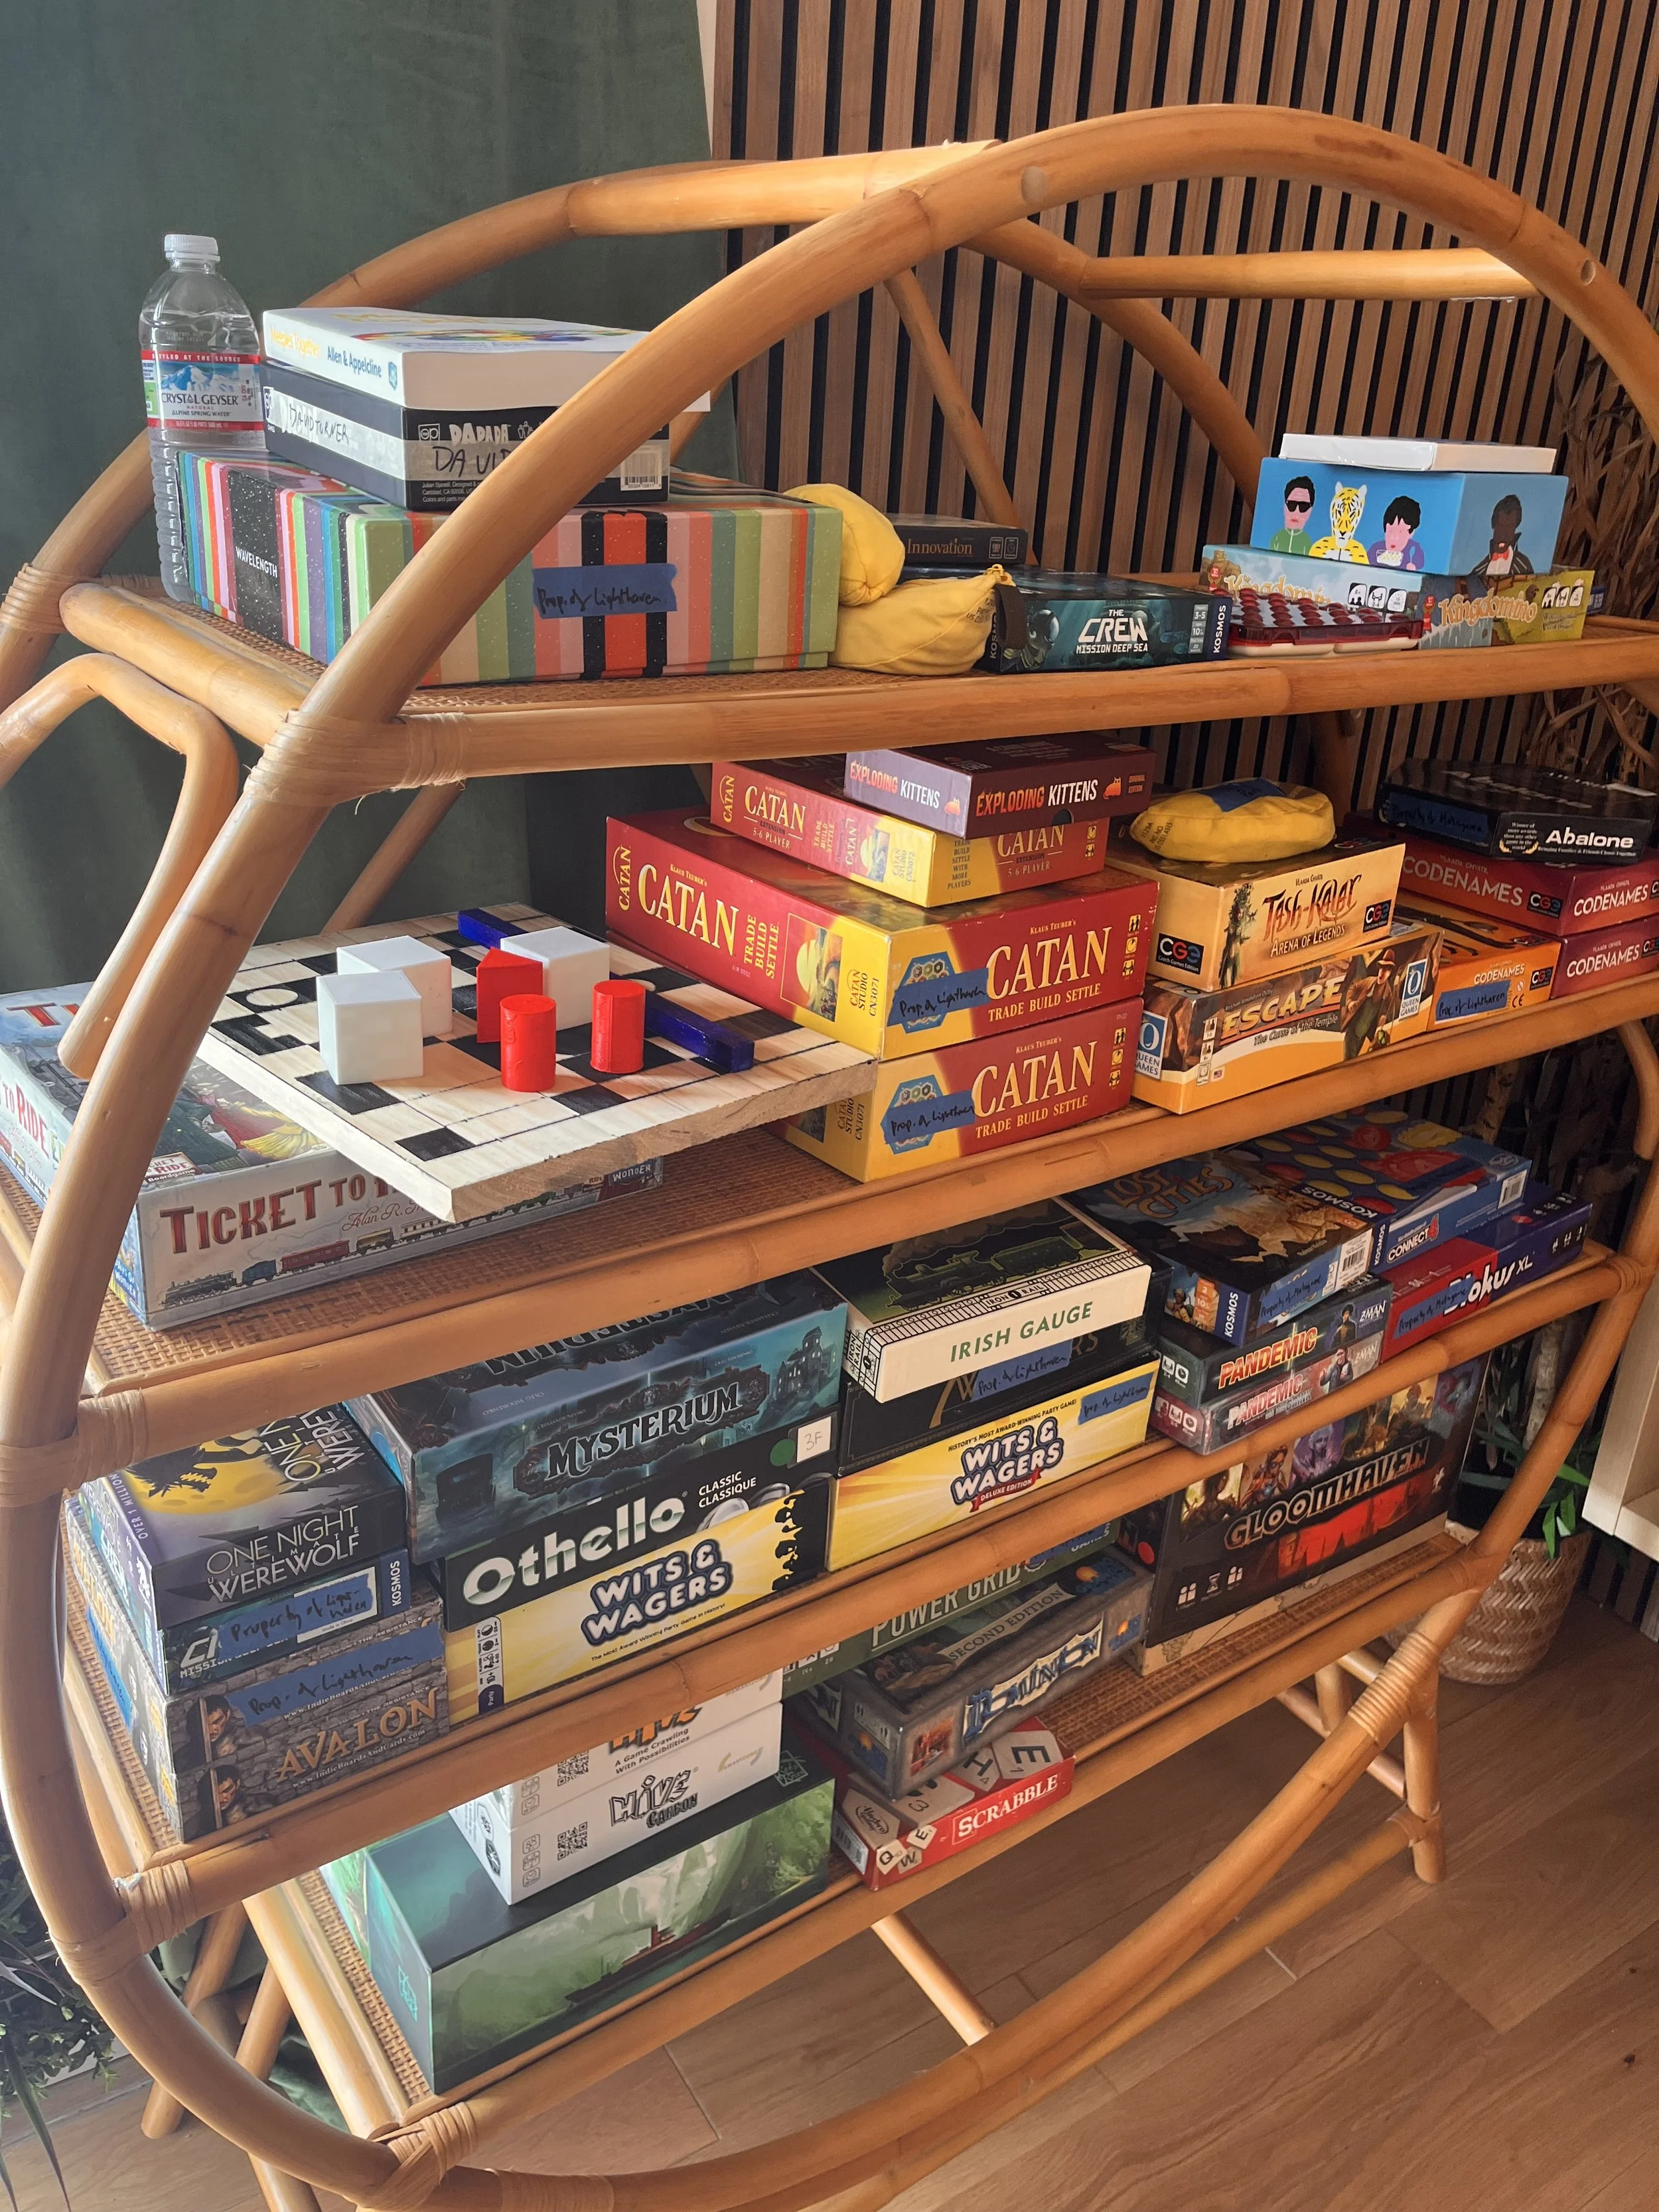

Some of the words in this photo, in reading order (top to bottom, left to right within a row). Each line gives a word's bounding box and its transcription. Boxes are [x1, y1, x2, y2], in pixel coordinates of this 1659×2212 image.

[162, 393, 200, 405] CRYSTAL
[202, 394, 238, 406] GEYSER
[290, 404, 314, 430] DAVID
[236, 546, 277, 578] WAVELENGTH
[906, 538, 972, 554] Innovation
[1439, 587, 1538, 627] Kingdomino
[1078, 618, 1148, 642] CREW
[1213, 605, 1226, 653] KOSMOS
[1076, 644, 1110, 654] MISSION
[1112, 644, 1131, 652] DEEP
[1133, 643, 1148, 652] SEA
[723, 775, 735, 822] CATAN
[849, 759, 898, 794] EXPLODING
[900, 779, 940, 809] KITTENS
[976, 785, 1044, 817] EXPLODING
[1048, 779, 1098, 806] KITTENS
[745, 786, 806, 834] CATAN
[753, 827, 762, 839] 5-6
[766, 832, 790, 850] PLAYER
[814, 820, 822, 848] TRADE
[845, 828, 857, 865] CATAN
[1546, 827, 1634, 848] Abalone
[670, 863, 684, 876] KLAUS
[685, 870, 707, 887] TEUBER'S
[899, 850, 907, 878] STUDIO
[952, 855, 970, 863] SETTLE
[1008, 869, 1019, 877] 5-6
[1023, 860, 1050, 875] PLAYER
[1016, 853, 1045, 863] EXTENSION
[618, 845, 631, 911] CATAN
[948, 881, 971, 889] PLAYERS
[1402, 856, 1524, 906] CODENAMES
[638, 864, 739, 956] CATAN
[1574, 884, 1648, 917] CODENAMES
[744, 915, 757, 964] TRADE
[755, 922, 767, 970] BUILD
[1030, 923, 1048, 935] KLAUS
[1050, 919, 1076, 932] TEUBER'S
[1271, 938, 1299, 958] ARENA
[1301, 936, 1311, 948] OF
[1313, 924, 1346, 944] LEGENDS
[766, 924, 779, 979] SETTLE
[987, 926, 1114, 1001] CATAN
[1567, 944, 1640, 978] CODENAMES
[849, 970, 861, 1006] CATAN
[859, 972, 868, 1010] STUDIO
[1473, 963, 1525, 986] CODENAMES
[869, 978, 879, 1017] CN3071
[988, 1004, 1025, 1022] TRADE
[1029, 994, 1061, 1012] BUILD
[1066, 983, 1102, 1003] SETTLE
[1222, 974, 1346, 1037] ESCAPE
[1400, 1005, 1418, 1016] GAMES
[1402, 997, 1419, 1008] QUEEN
[1512, 994, 1524, 1008] CE
[1016, 1043, 1035, 1054] KLAUS
[1036, 1035, 1062, 1049] TEUBER'S
[1254, 1033, 1267, 1045] The
[1269, 1029, 1289, 1041] Curse
[1292, 1023, 1301, 1034] of
[1301, 1020, 1313, 1031] the
[1315, 1013, 1338, 1028] Temple
[972, 1041, 1098, 1118] CATAN
[3, 1083, 15, 1114] TO
[16, 1084, 49, 1159] RIDE
[845, 1098, 854, 1134] STUDIO
[855, 1103, 865, 1141] CN3071
[975, 1120, 1011, 1139] TRADE
[1017, 1107, 1049, 1126] BUILD
[1053, 1095, 1088, 1116] SETTLE
[147, 1169, 196, 1182] Boardgame
[154, 1163, 190, 1174] RIDE
[613, 1164, 651, 1181] WONDER
[1108, 1168, 1168, 1207] LOST
[1137, 1168, 1234, 1218] CITIES
[1301, 1186, 1378, 1218] KOSMOS
[160, 1180, 321, 1254] TICKET
[329, 1174, 366, 1207] TO
[1374, 1224, 1386, 1266] KOSMOS
[1388, 1228, 1429, 1262] CONNECT
[1427, 1213, 1439, 1241] 4
[950, 1329, 1010, 1363] IRISH
[1020, 1301, 1093, 1339] GAUGE
[1224, 1291, 1239, 1337] KOSMOS
[1218, 1327, 1319, 1390] PANDEMIC
[1227, 1373, 1307, 1430] PANDEMIC
[545, 1383, 741, 1481] MYSTERIUM
[805, 1432, 824, 1452] 3F
[948, 1436, 977, 1452] HISTORY'S
[978, 1429, 994, 1441] MOST
[995, 1412, 1041, 1436] AWARD-WINNING
[1042, 1406, 1058, 1418] PARTY
[1060, 1398, 1076, 1410] GAME!
[964, 1429, 1033, 1474] WITS
[1039, 1420, 1054, 1443] &
[109, 1474, 134, 1507] MILLION
[699, 1471, 743, 1496] CLASSIC
[953, 1443, 1060, 1501] WAGERS
[980, 1486, 1005, 1501] DELUXE
[1006, 1478, 1033, 1493] EDITION
[699, 1477, 757, 1509] CLASSIQUE
[1224, 1438, 1430, 1550] GLOOMHAVEN
[132, 1517, 149, 1539] OVER
[206, 1536, 270, 1574] ONE
[277, 1505, 358, 1553] NIGHT
[209, 1532, 360, 1603] WEREWOLF
[464, 1497, 685, 1606] Othello
[390, 1560, 401, 1607] KOSMOS
[594, 1554, 685, 1609] WITS
[695, 1544, 715, 1570] &
[585, 1566, 727, 1641] WAGERS
[231, 1604, 302, 1642] Property
[376, 1617, 423, 1638] RESISTANCE
[603, 1648, 618, 1657] Most
[619, 1639, 638, 1651] Award
[639, 1629, 663, 1643] Winning
[664, 1622, 680, 1633] Party
[680, 1615, 697, 1625] Game
[704, 1603, 725, 1616] History!
[949, 1623, 1005, 1660] SECOND
[1006, 1589, 1064, 1626] EDITION
[383, 1686, 430, 1708] RESISTANCE
[275, 1687, 439, 1783] AVALON
[624, 1747, 648, 1763] Game
[651, 1728, 689, 1749] Crawling
[1011, 1745, 1050, 1763] E
[615, 1761, 636, 1774] With
[638, 1735, 690, 1763] Possibilities
[958, 1774, 1058, 1837] SCRABBLE
[915, 1828, 929, 1841] E
